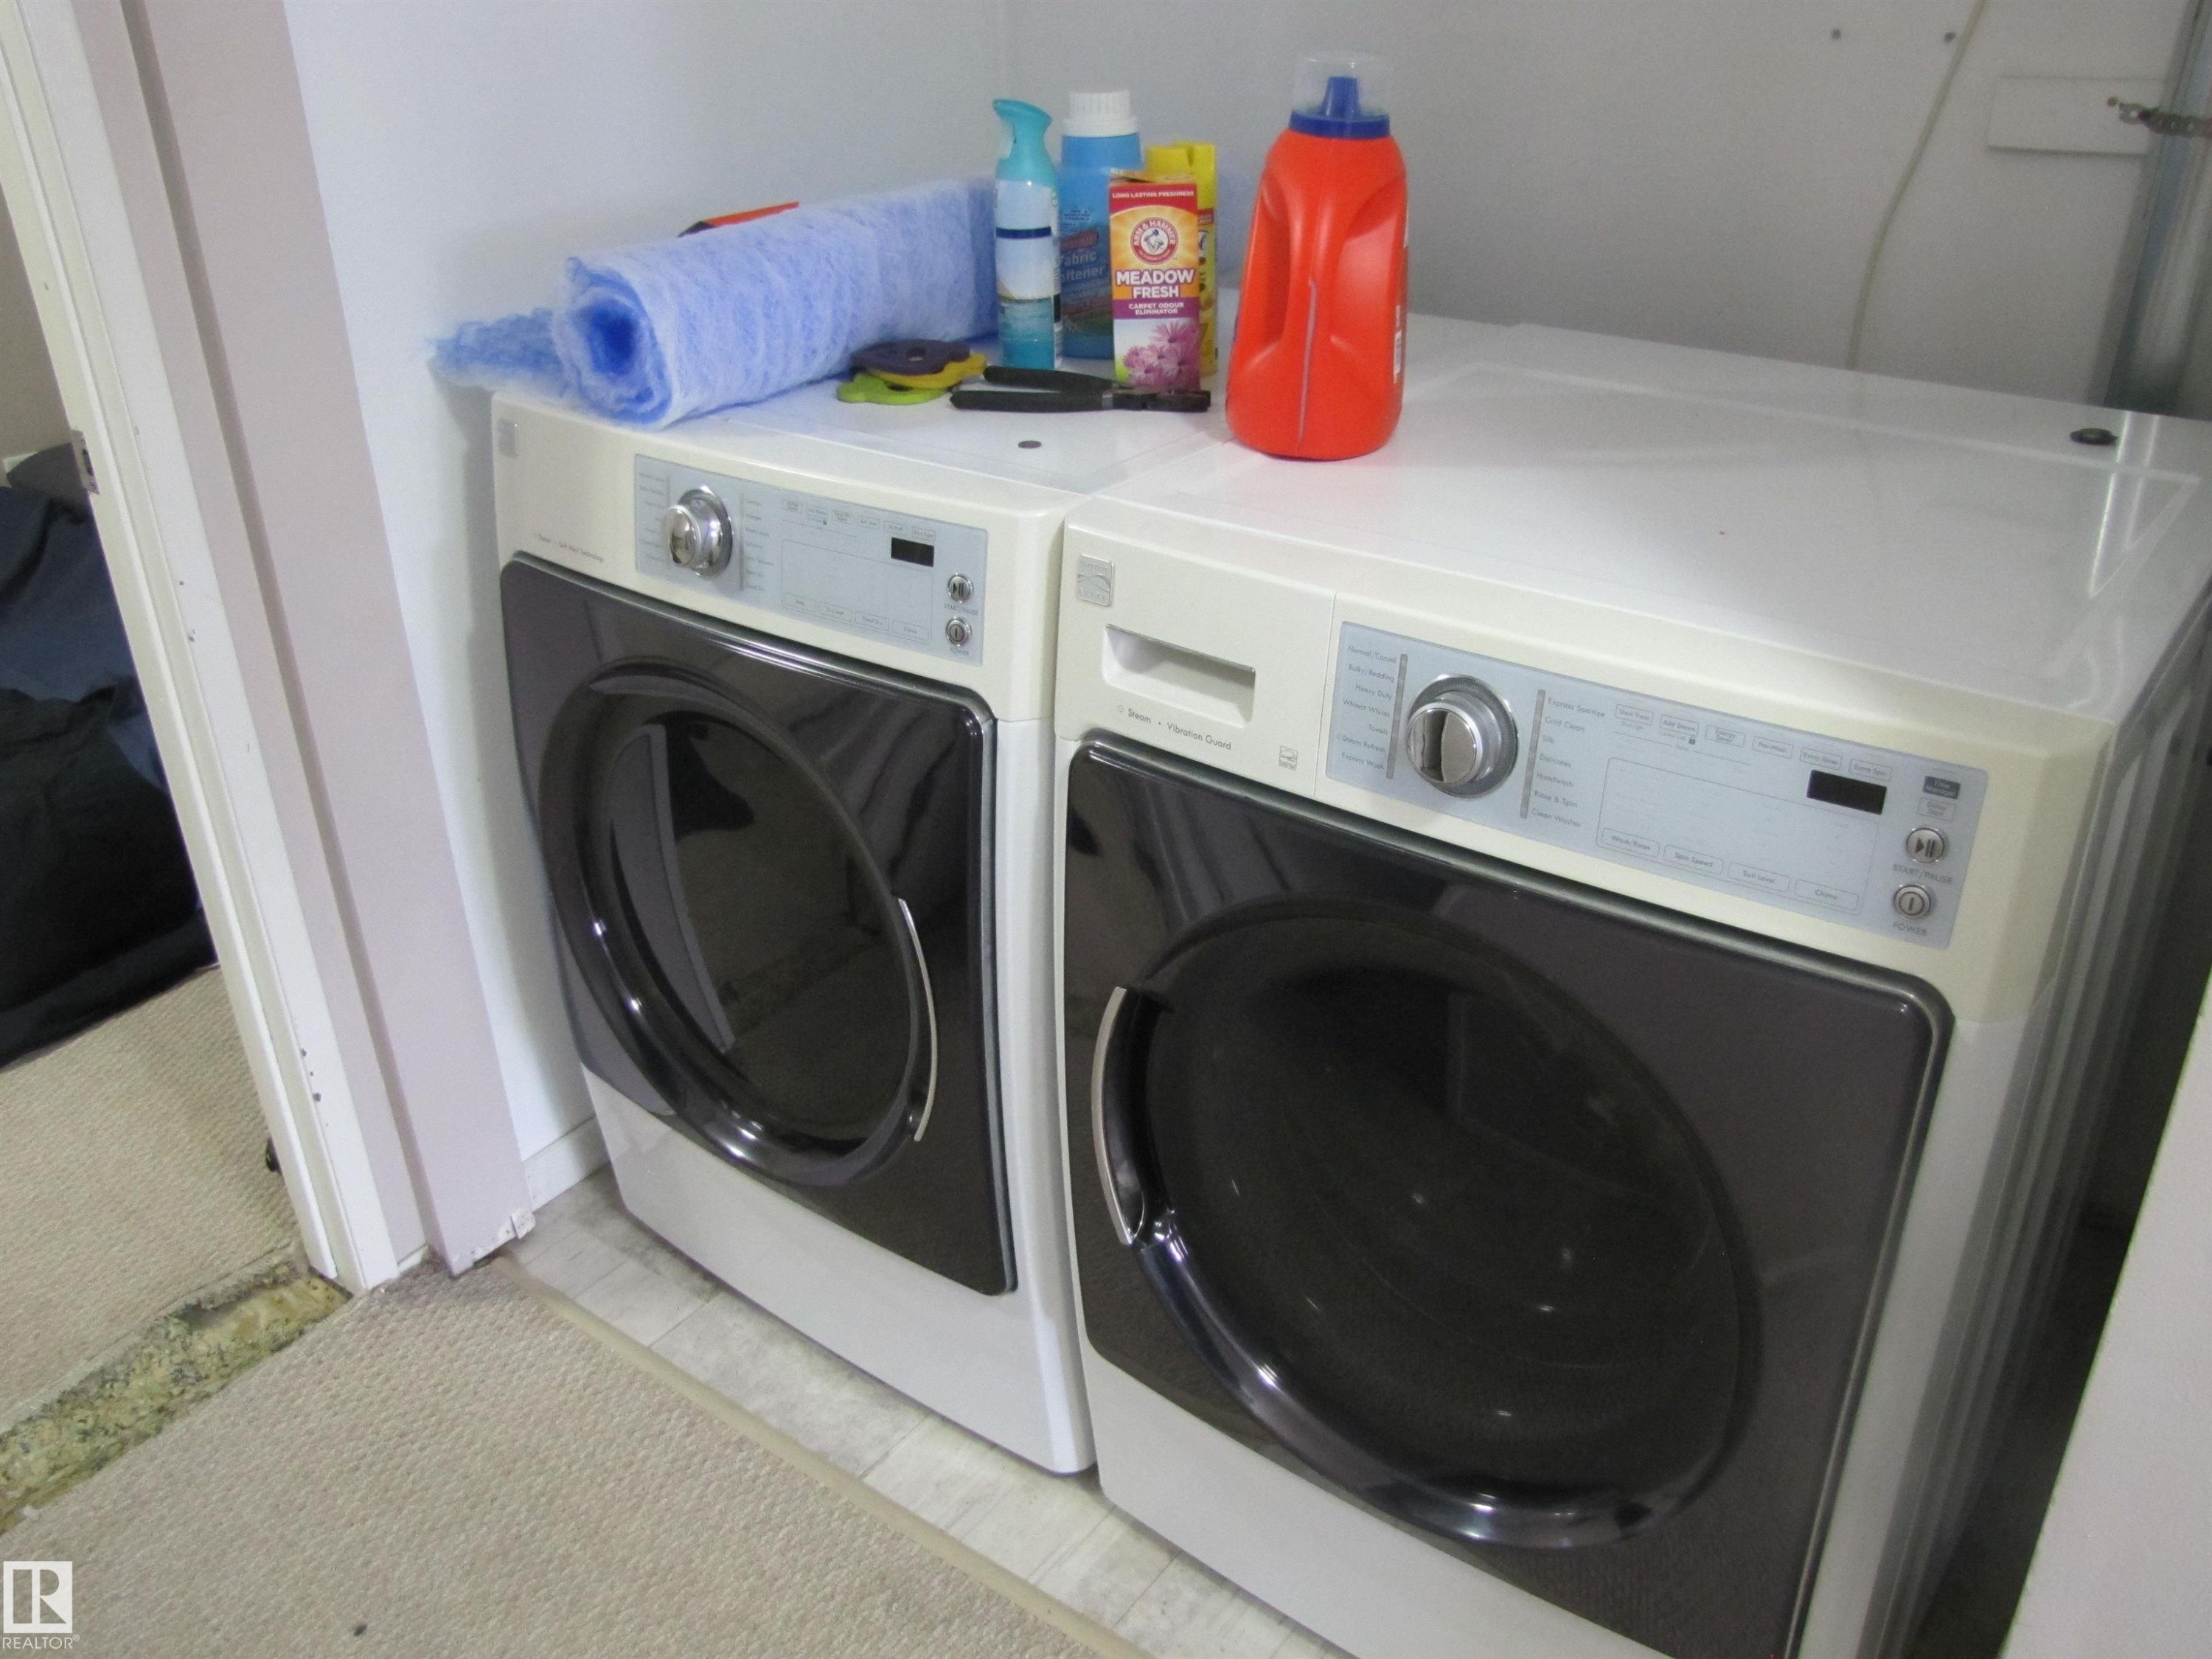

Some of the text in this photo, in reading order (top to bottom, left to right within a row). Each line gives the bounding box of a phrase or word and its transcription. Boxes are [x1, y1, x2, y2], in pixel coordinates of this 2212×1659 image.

[1133, 228, 1144, 246] ARM
[1150, 220, 1176, 245] HAMMER
[1116, 269, 1194, 286] MEADOW
[1132, 285, 1180, 299] FRESH
[1348, 646, 1397, 664] Normal/Casual
[1348, 664, 1394, 683] Bulky/Bedding
[1356, 684, 1392, 701] Heavy Duty
[1548, 698, 1605, 717] Express Sanitize
[1127, 708, 1232, 751] Steam Vibration Guard
[1368, 724, 1388, 736] Towels
[1545, 716, 1585, 732] Cold Clean
[1342, 735, 1387, 753] Steam Refresh
[1342, 752, 1385, 770] Express Wash
[1539, 754, 1571, 768] Delicates
[1536, 771, 1573, 787] Handwash
[1534, 790, 1552, 801] Rinse
[1562, 798, 1577, 808] Spin
[1531, 808, 1581, 827] Clean Washer
[1893, 863, 1953, 884] START/PAUSE
[1892, 922, 1927, 937] POWER
